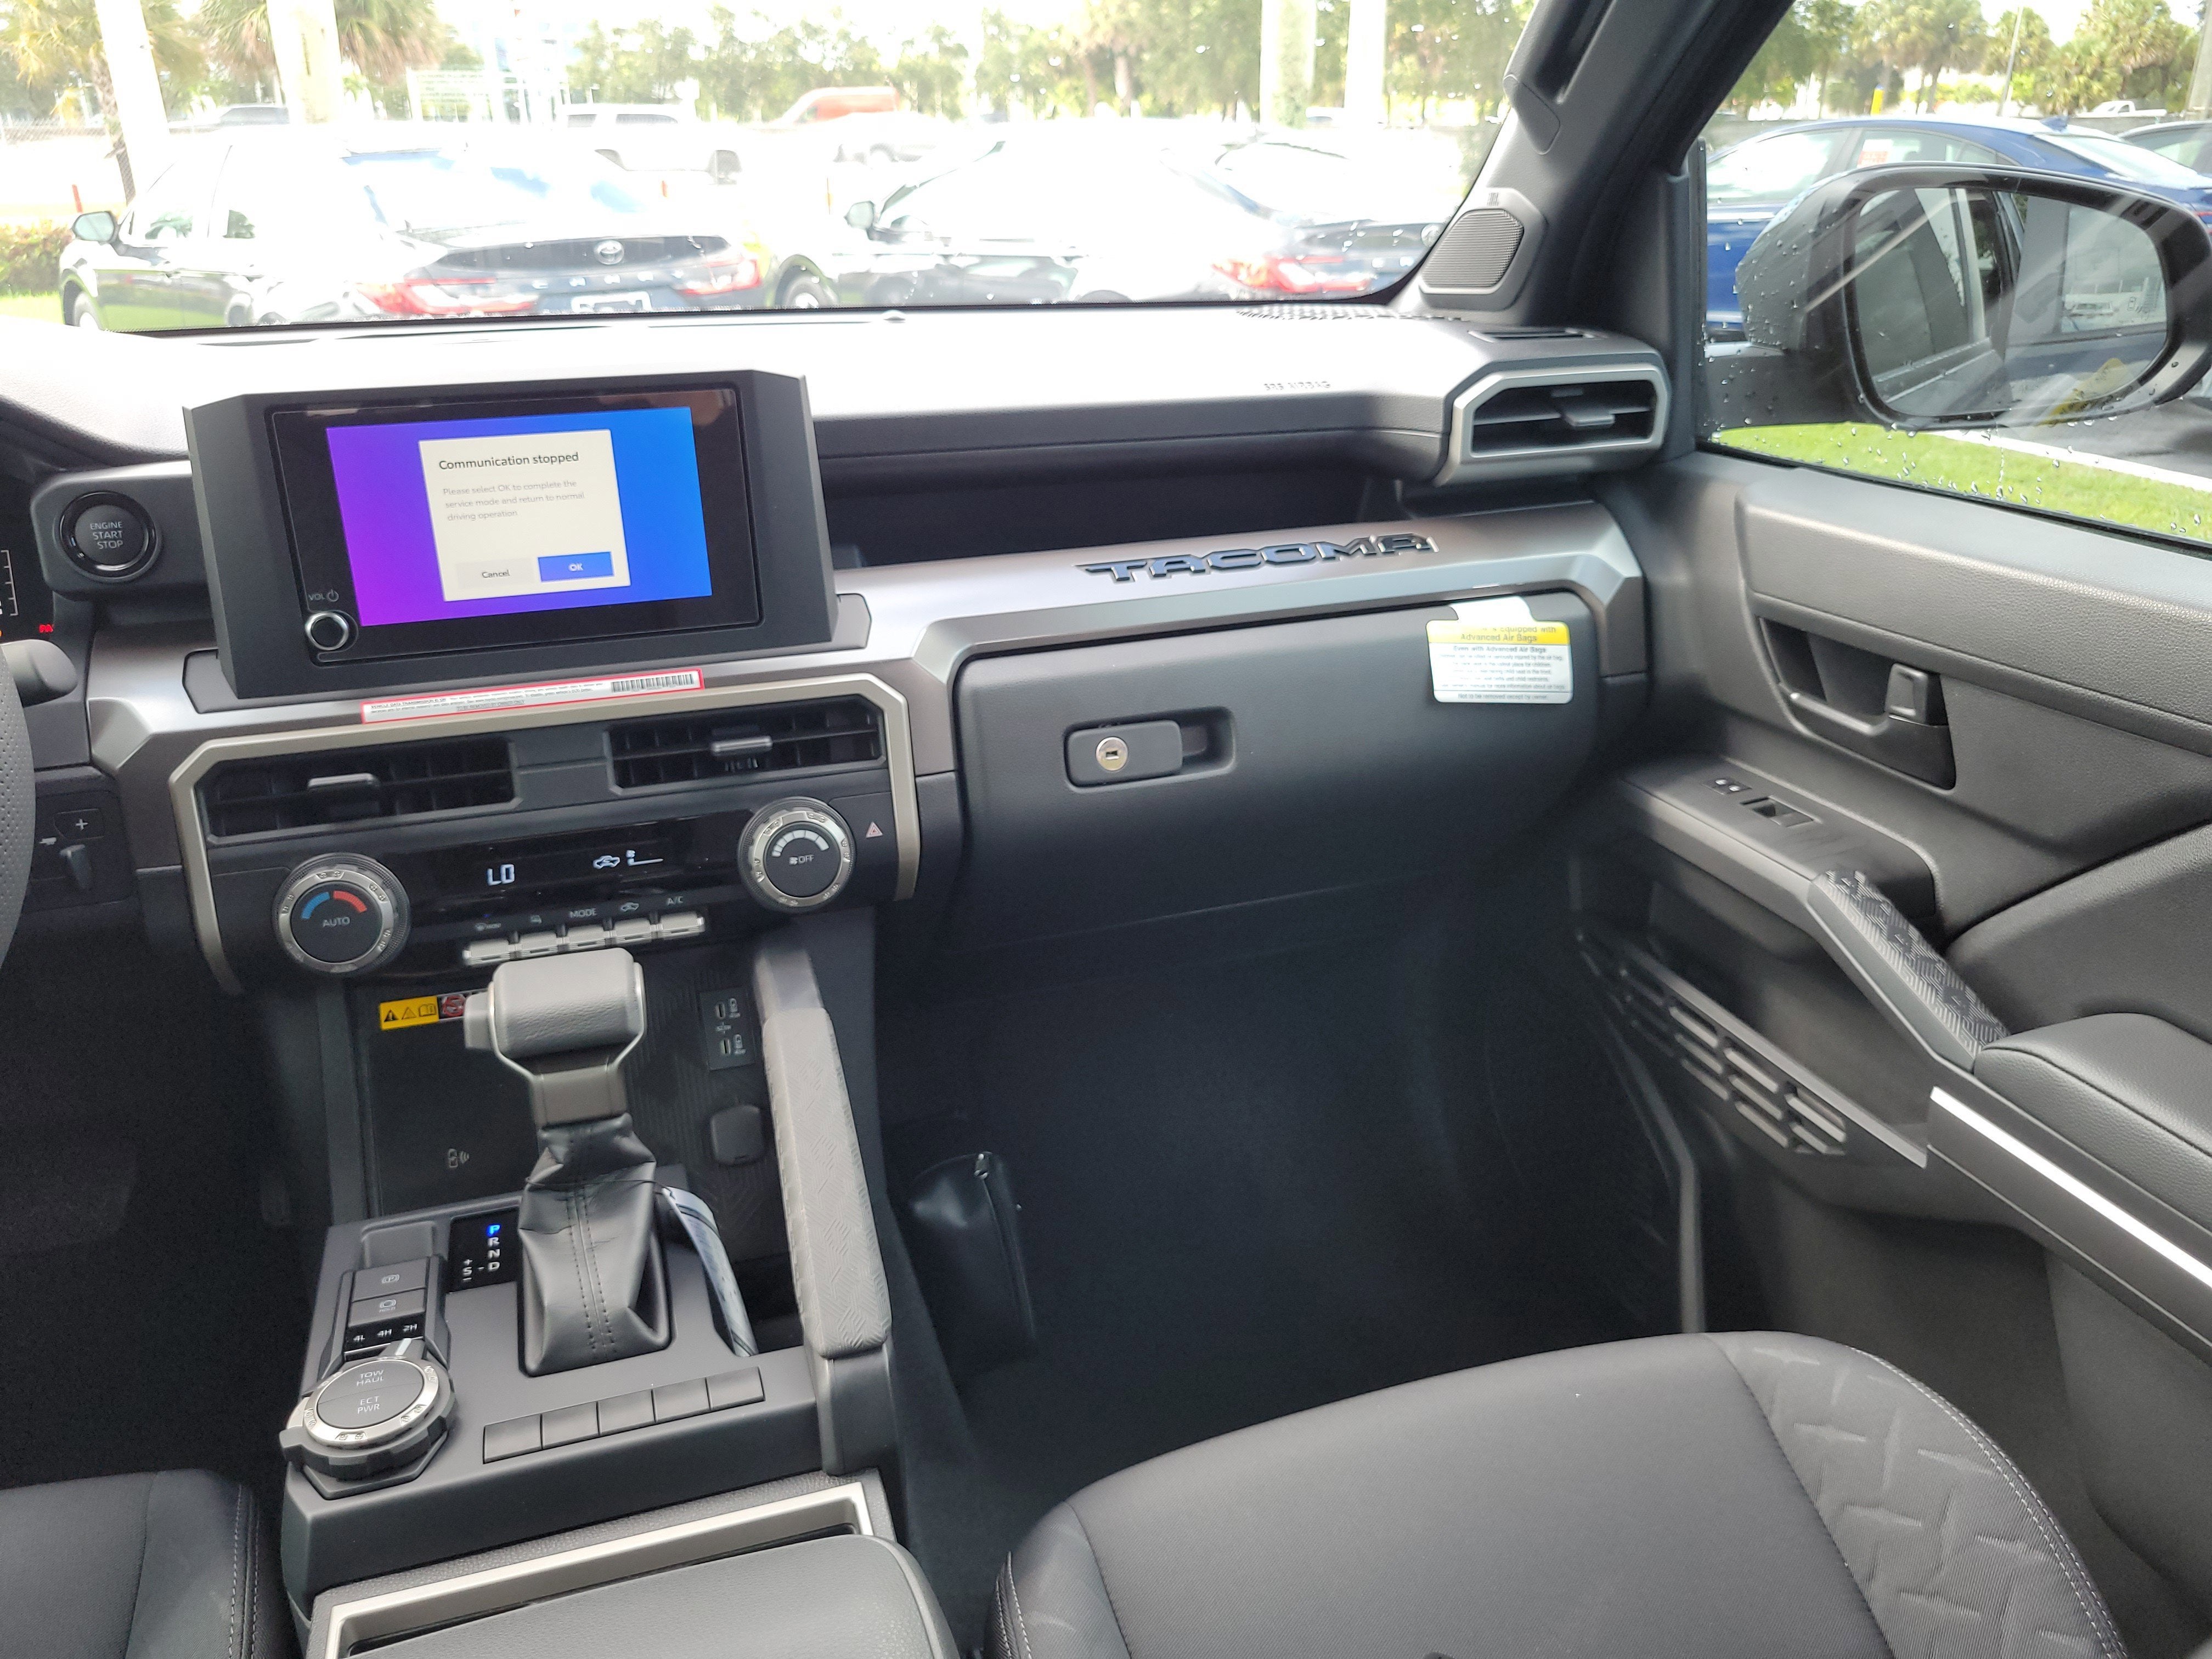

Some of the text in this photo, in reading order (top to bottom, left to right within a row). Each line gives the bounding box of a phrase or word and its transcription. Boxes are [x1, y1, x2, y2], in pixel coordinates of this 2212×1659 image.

[439, 452, 579, 470] Communication stopped
[523, 482, 562, 492] complete
[519, 495, 544, 504] return
[556, 492, 585, 500] normal
[447, 510, 517, 521] driving operation
[89, 522, 123, 530] ENGINE
[93, 531, 123, 540] START
[97, 540, 123, 549] STOP
[1074, 533, 1439, 582] TACOMA
[482, 562, 584, 579] Cancel OK
[1460, 633, 1500, 641] Advanced
[1516, 633, 1537, 644] Bags
[798, 854, 815, 864] OFF
[666, 896, 684, 906] A/C
[569, 908, 597, 919] MODE
[323, 917, 350, 927] AUTO
[487, 1224, 500, 1235] P
[488, 1237, 500, 1247] R
[488, 1249, 500, 1259] N
[462, 1266, 472, 1276] S
[488, 1262, 500, 1272] D
[403, 1323, 417, 1332] 2H
[377, 1329, 392, 1337] 4H
[360, 1370, 384, 1379] TOW
[357, 1376, 384, 1386] HAUL
[360, 1396, 380, 1406] ECT
[358, 1403, 380, 1414] PWR
